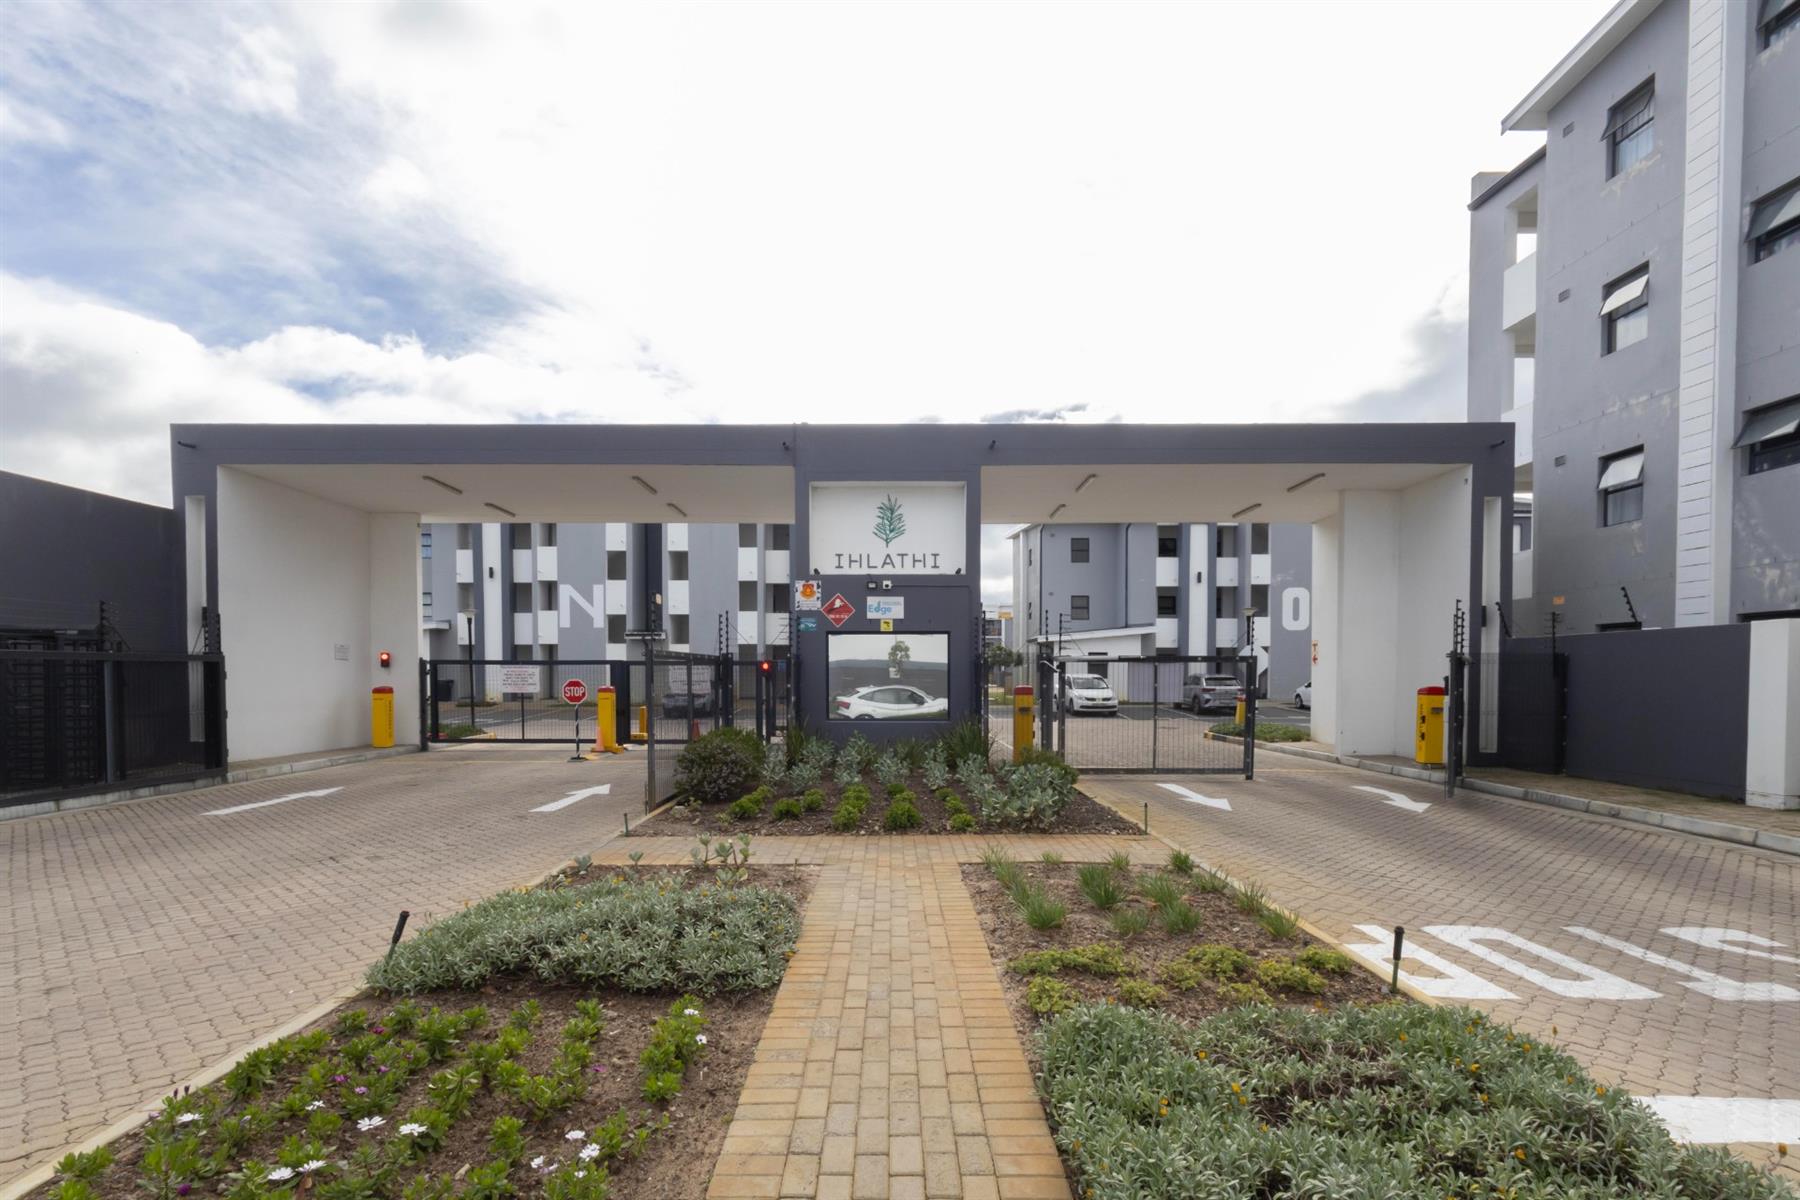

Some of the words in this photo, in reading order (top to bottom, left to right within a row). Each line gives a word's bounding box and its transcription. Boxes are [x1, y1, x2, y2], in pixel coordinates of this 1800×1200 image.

[834, 553, 941, 569] IHLATHI
[559, 584, 605, 628] N
[868, 601, 892, 616] Edge
[564, 686, 585, 697] STOP
